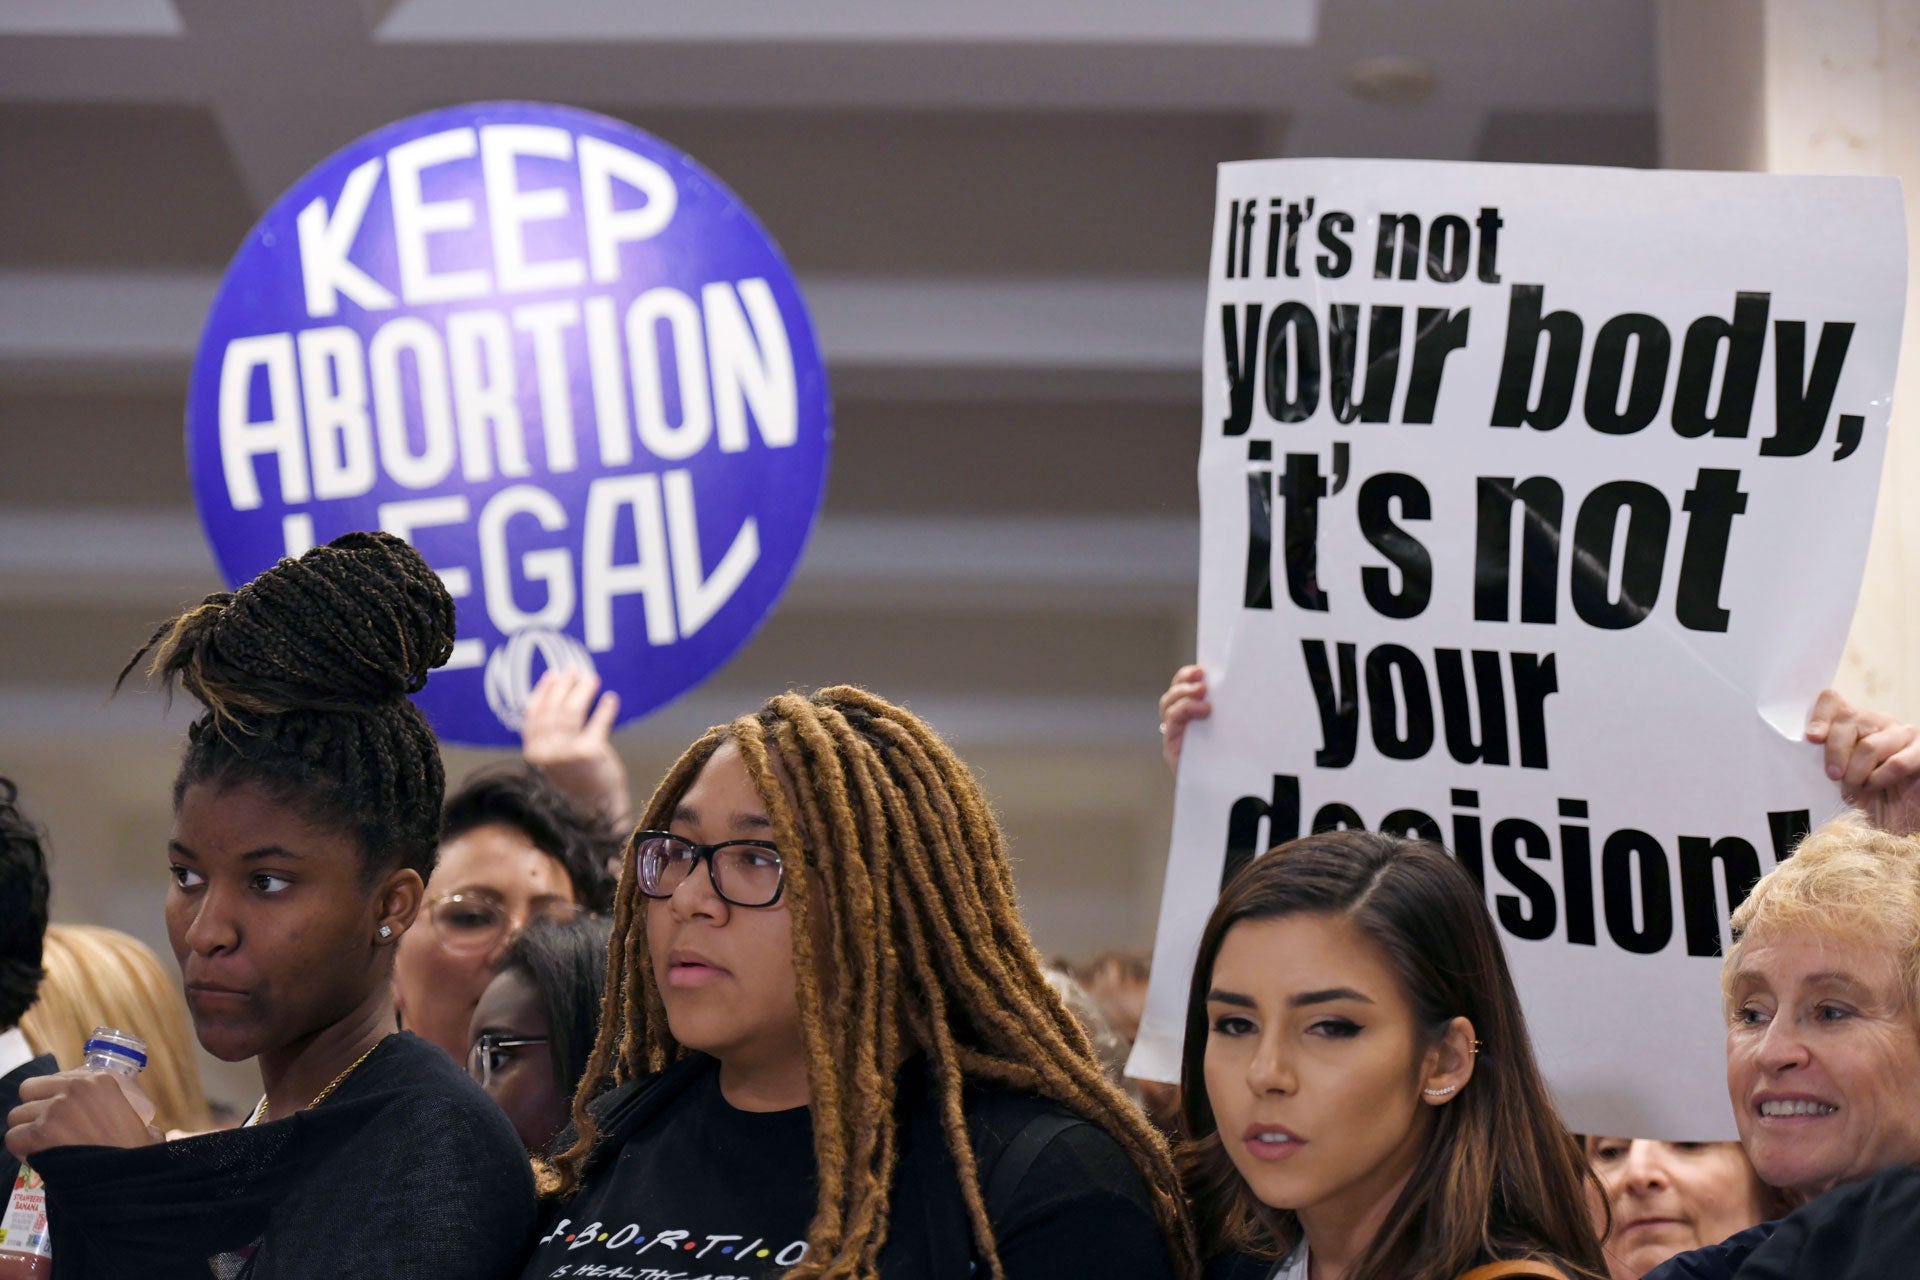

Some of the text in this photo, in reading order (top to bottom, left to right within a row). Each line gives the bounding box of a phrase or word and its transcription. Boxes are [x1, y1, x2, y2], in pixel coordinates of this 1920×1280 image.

[296, 123, 677, 318] KEEP
[1226, 197, 1504, 284] If it's not
[218, 277, 799, 512] ABORTION
[1221, 283, 1866, 462] your body,
[281, 469, 761, 670] EGAL
[1243, 440, 1749, 633] it's not
[1300, 639, 1559, 770] your
[15, 1201, 39, 1211] BANANA
